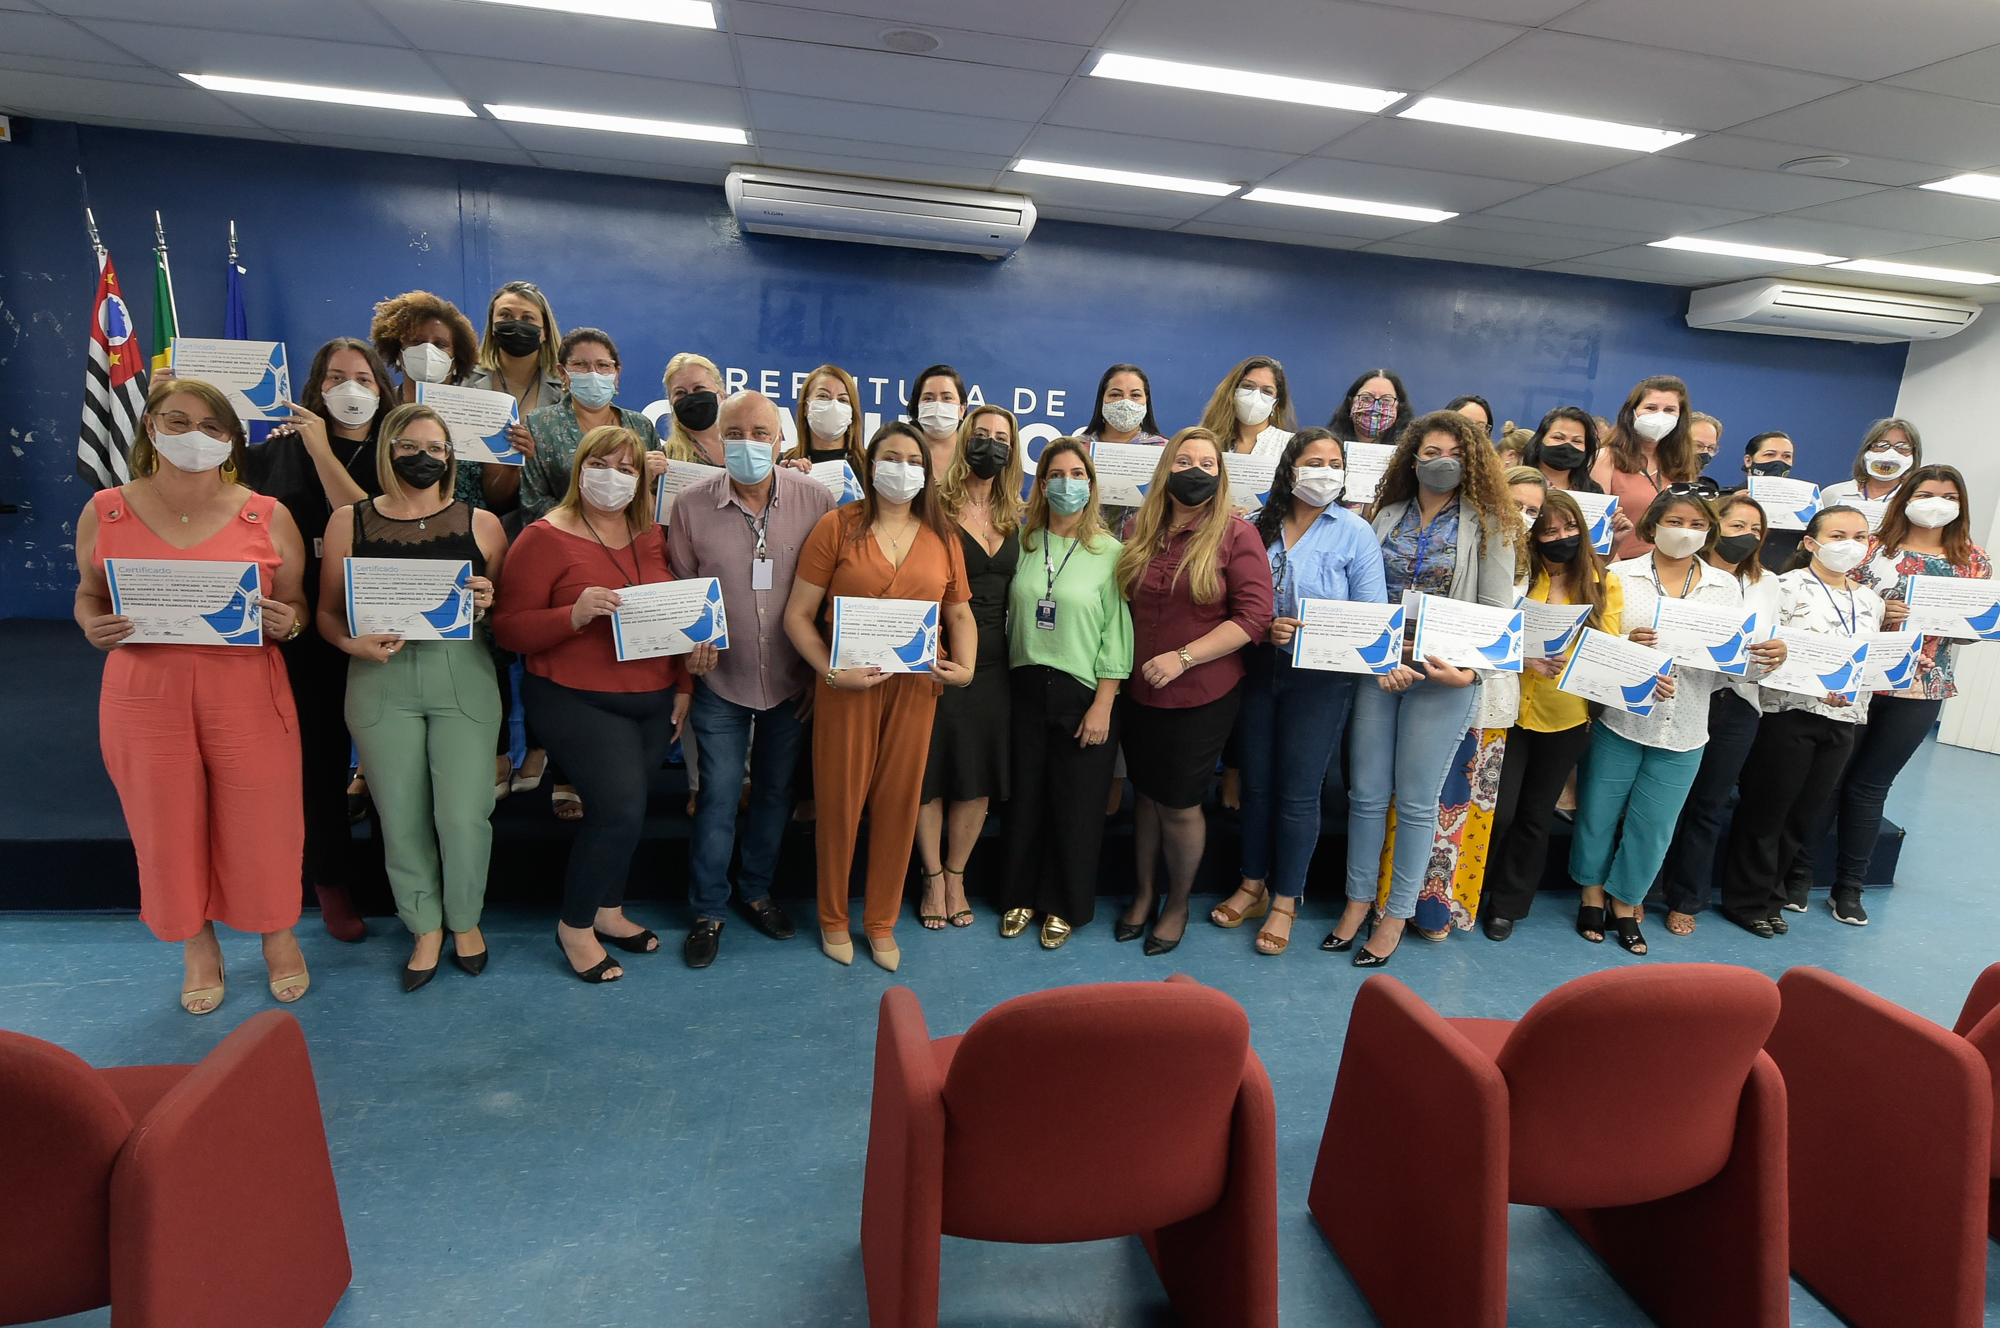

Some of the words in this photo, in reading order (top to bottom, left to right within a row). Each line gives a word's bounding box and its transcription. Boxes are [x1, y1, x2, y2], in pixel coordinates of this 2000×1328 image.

[426, 389, 465, 399] Certificado
[1013, 387, 1067, 418] DE
[668, 465, 702, 474] Certificado
[118, 566, 172, 574] Certificado
[1308, 604, 1343, 612] Certificado
